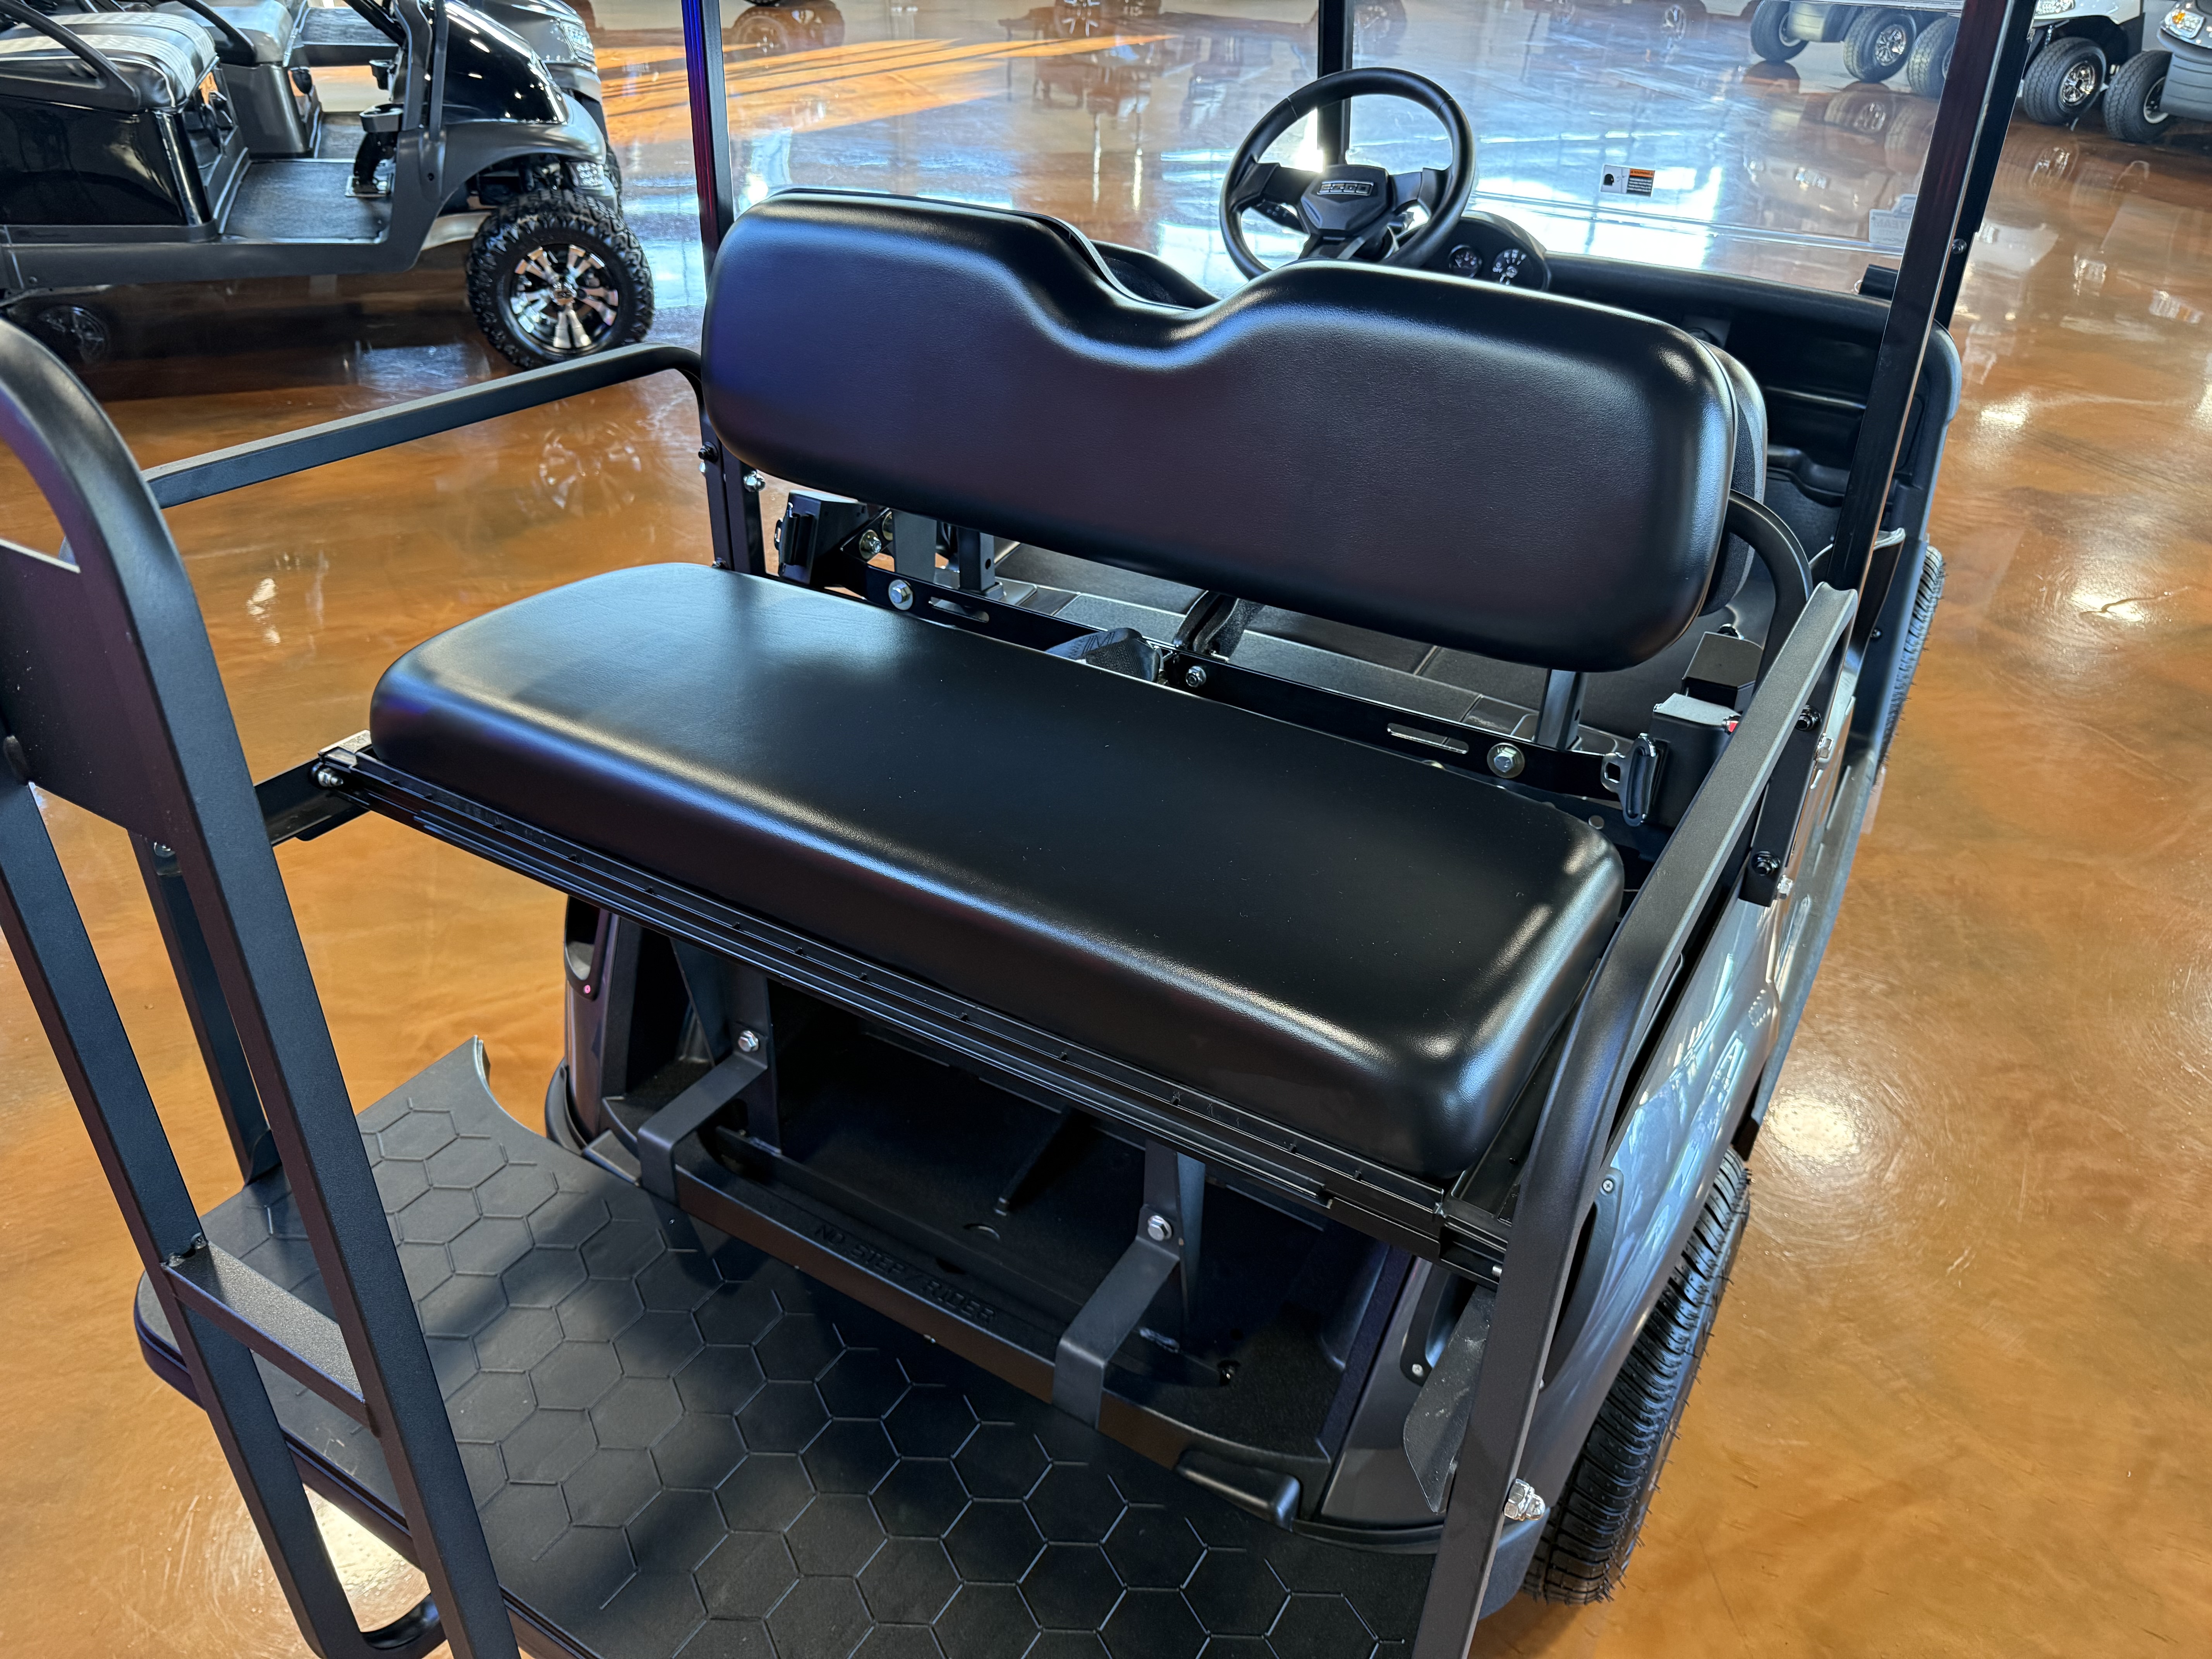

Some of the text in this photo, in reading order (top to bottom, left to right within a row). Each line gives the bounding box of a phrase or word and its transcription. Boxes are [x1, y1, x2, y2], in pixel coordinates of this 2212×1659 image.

[814, 1223, 845, 1245] NO
[851, 1244, 905, 1275] STEP
[922, 1279, 996, 1326] RIDER
